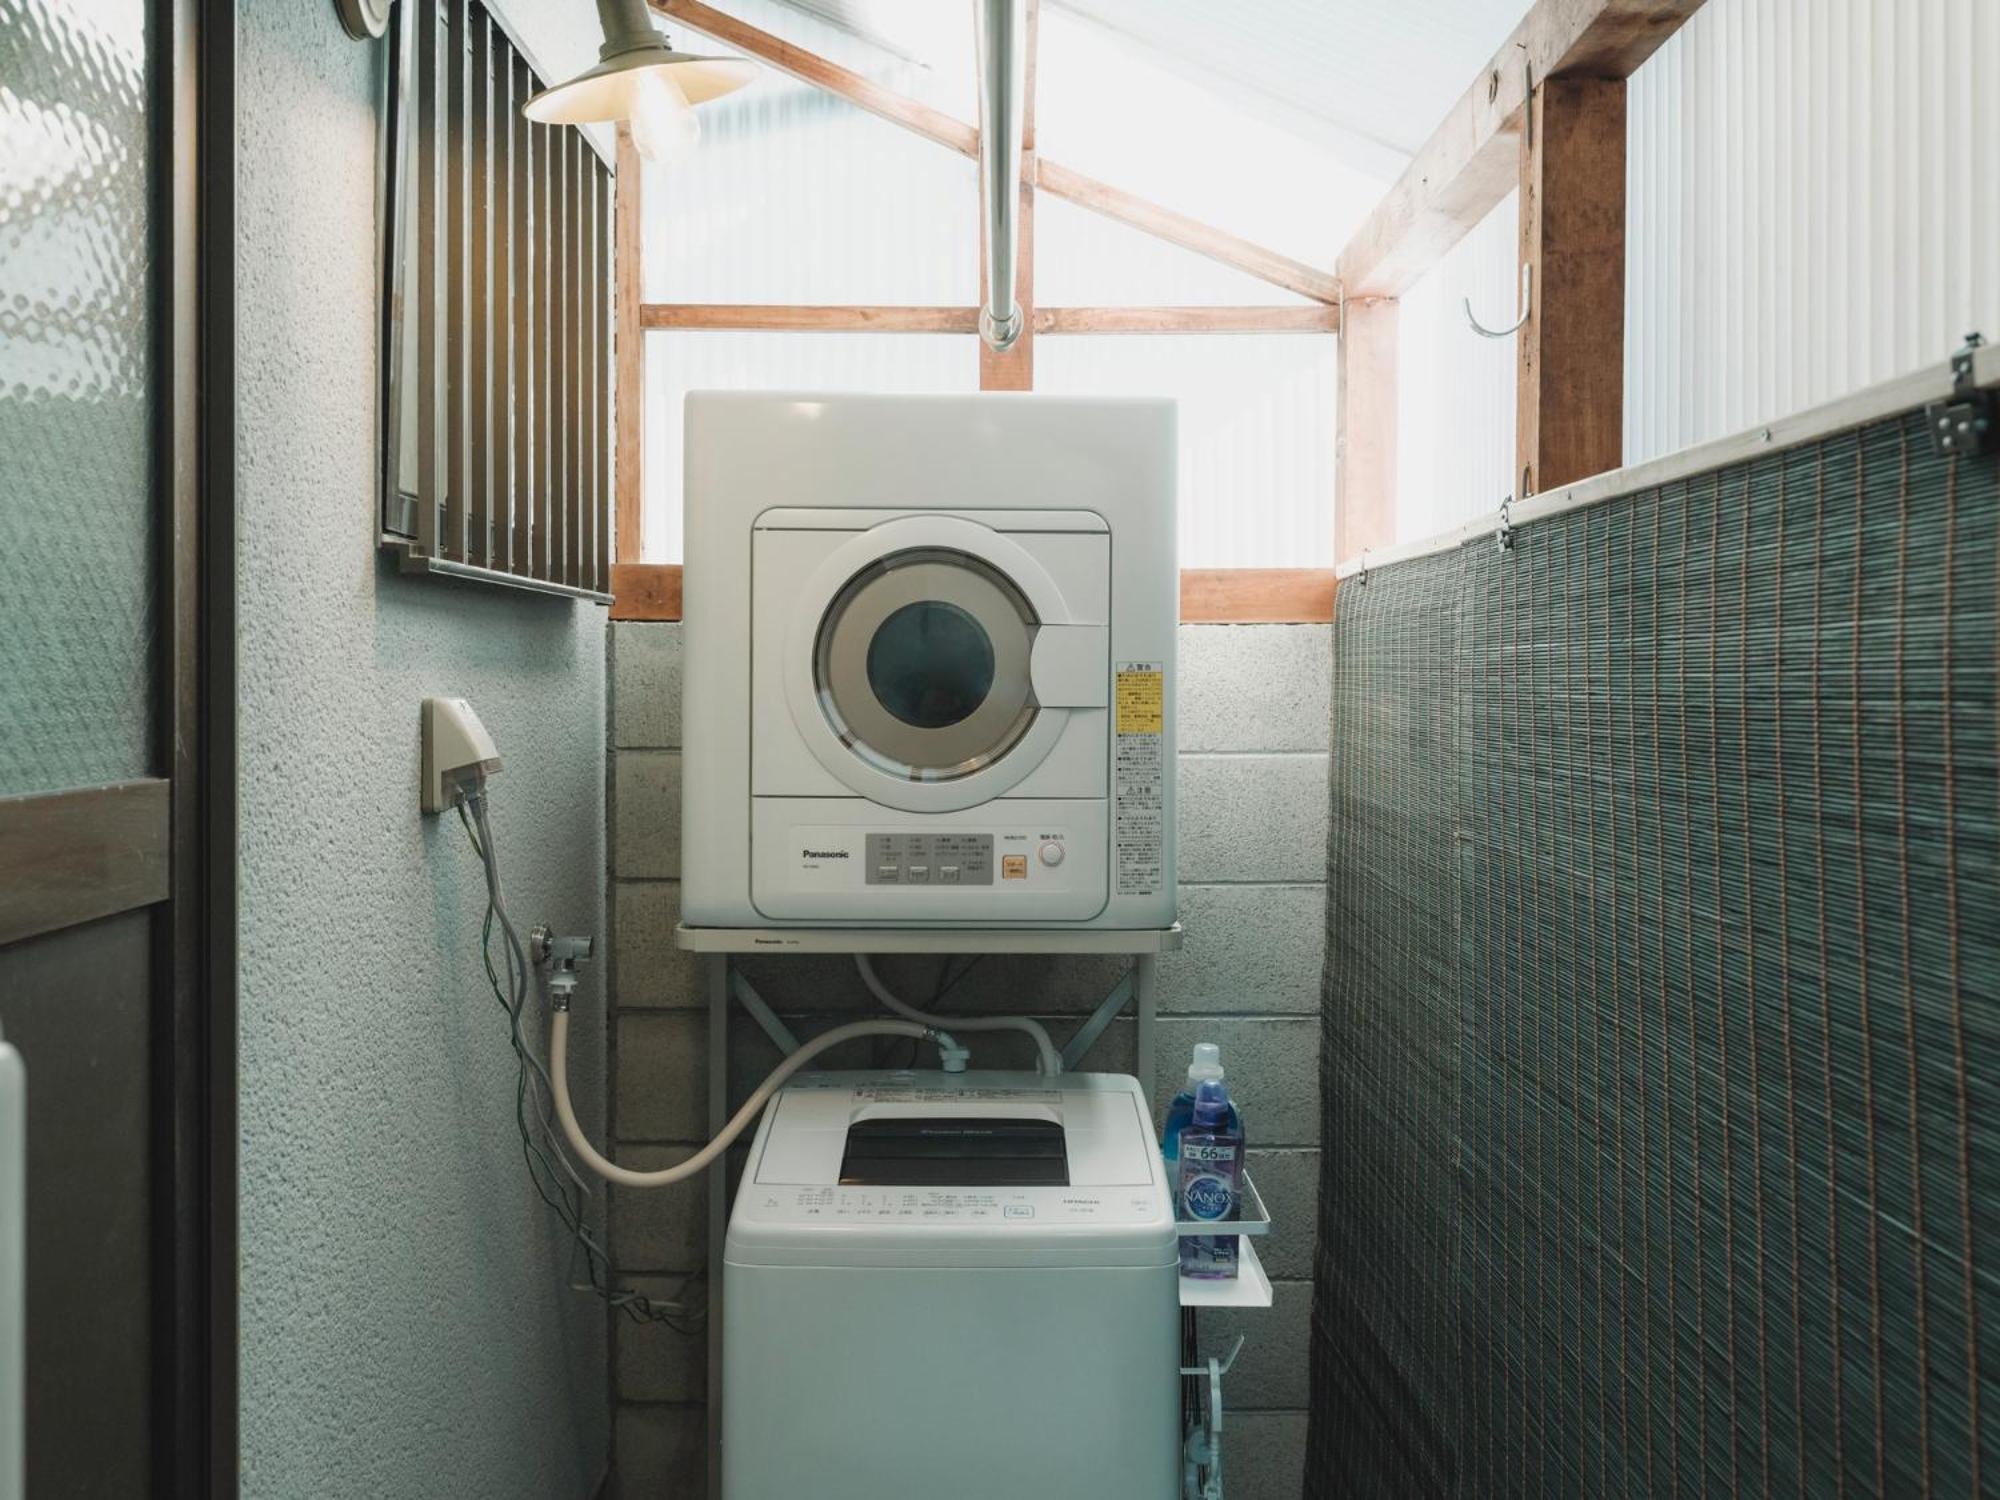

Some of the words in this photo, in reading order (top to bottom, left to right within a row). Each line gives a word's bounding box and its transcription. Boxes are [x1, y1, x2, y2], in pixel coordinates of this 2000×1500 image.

[802, 849, 849, 859] Panasonic
[1200, 1147, 1218, 1160] 66
[1184, 1190, 1232, 1204] NANOX
